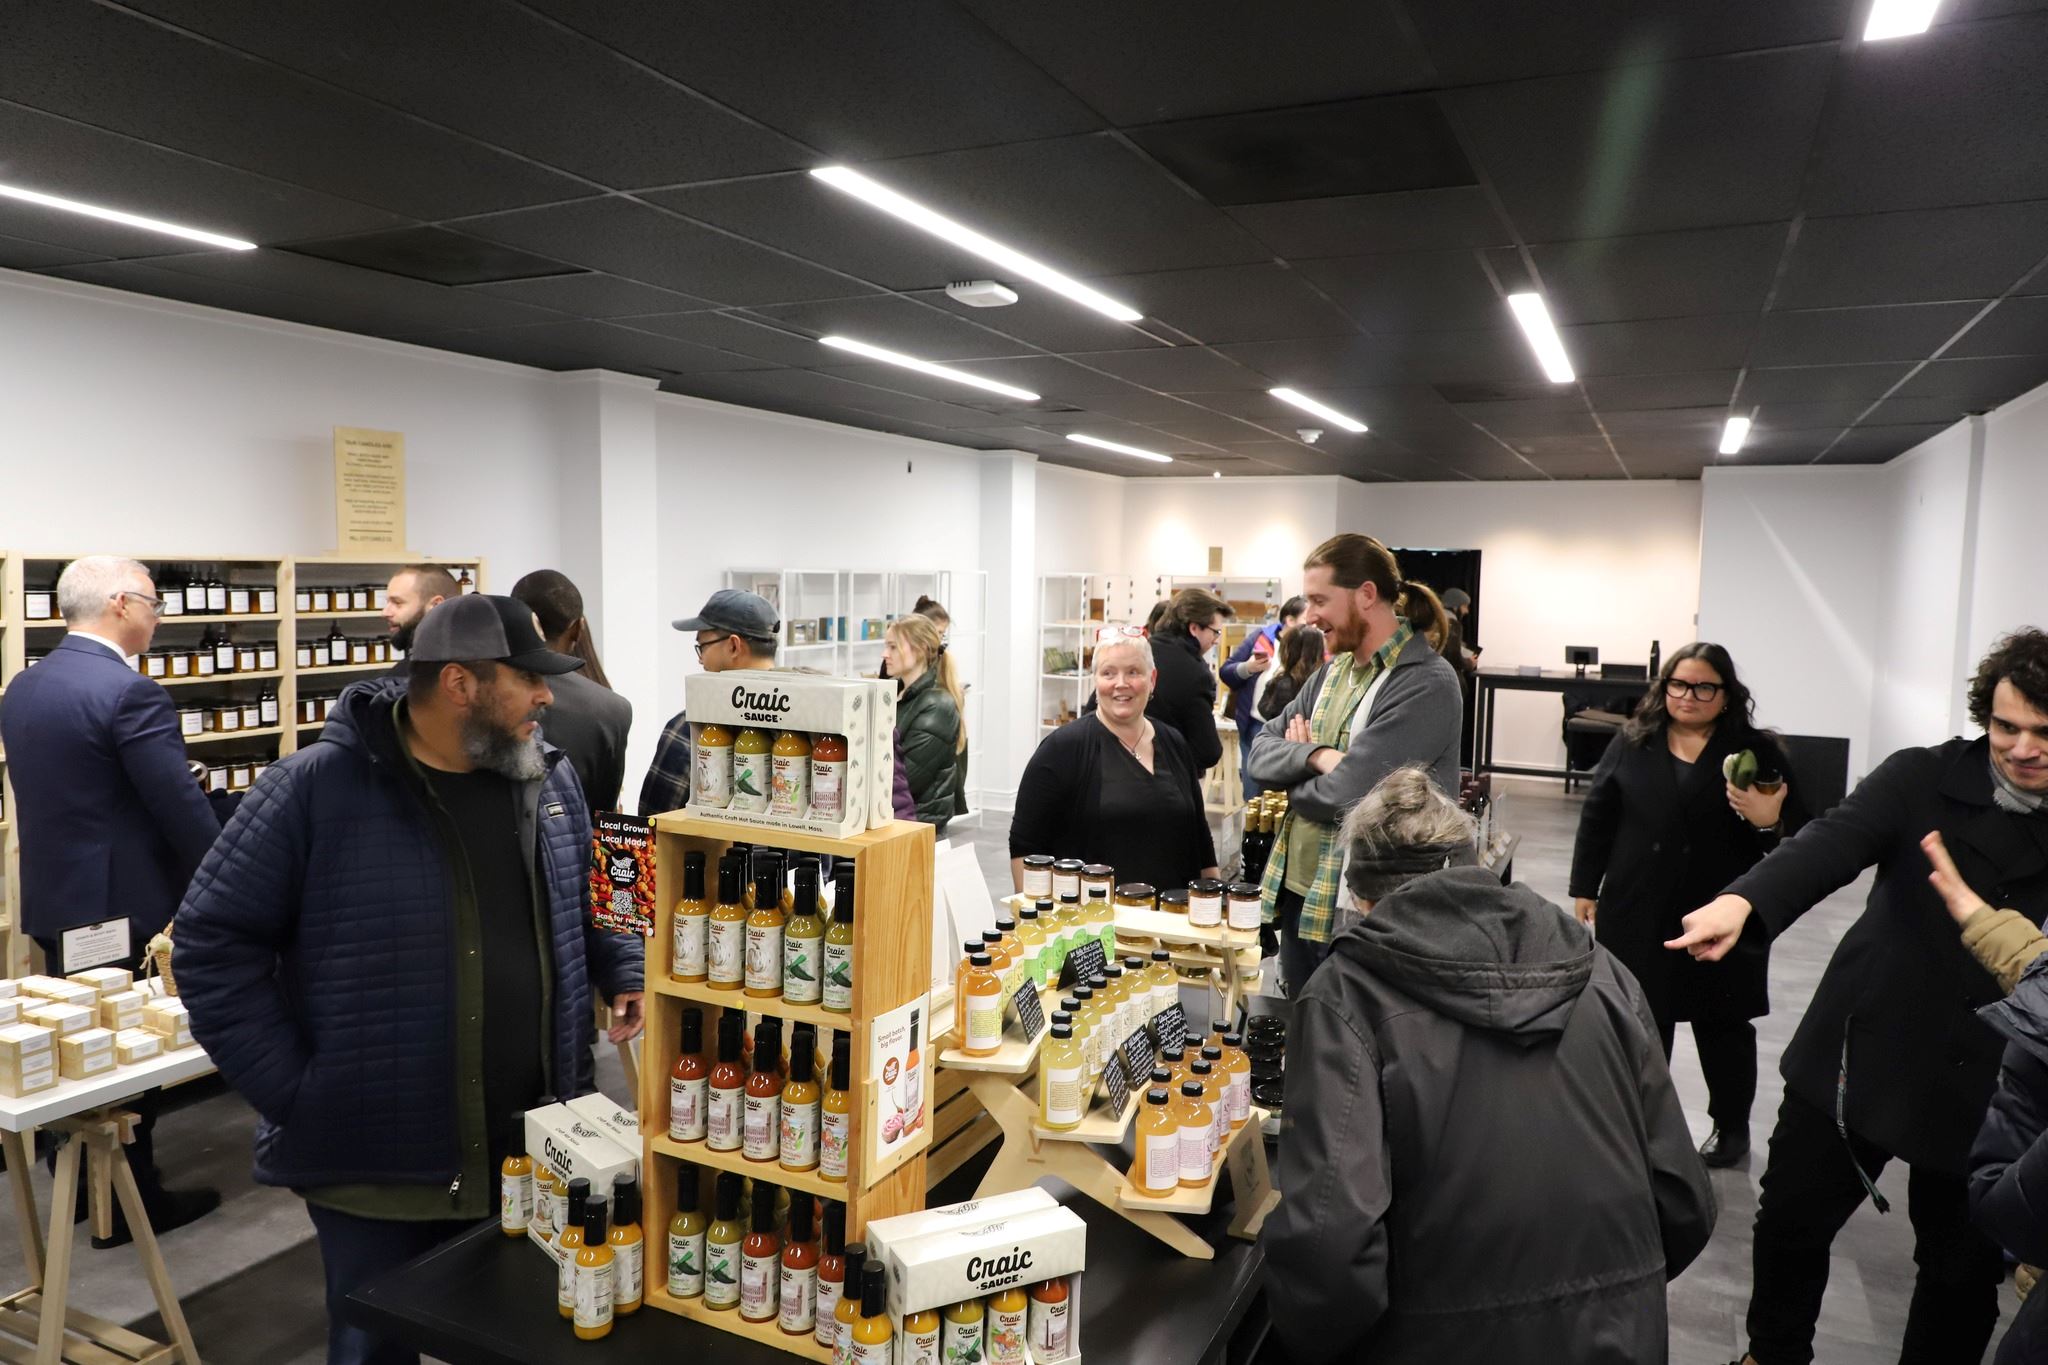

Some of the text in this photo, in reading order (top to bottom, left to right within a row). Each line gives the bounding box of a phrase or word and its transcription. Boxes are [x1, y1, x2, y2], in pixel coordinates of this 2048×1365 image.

[732, 686, 790, 712] Craic
[744, 712, 778, 722] SAUCE
[813, 763, 832, 773] Craic
[600, 820, 649, 834] Local Grown
[601, 834, 647, 847] Local Made
[610, 865, 635, 878] Craic
[826, 945, 845, 956] Craic
[782, 1104, 796, 1114] raic
[544, 1136, 572, 1175] Craic
[966, 1246, 1033, 1282] Craic
[980, 1274, 1019, 1291] SAUCE
[1000, 1314, 1021, 1322] Craic
[958, 1325, 979, 1335] Craic
[915, 1334, 936, 1345] Craic
